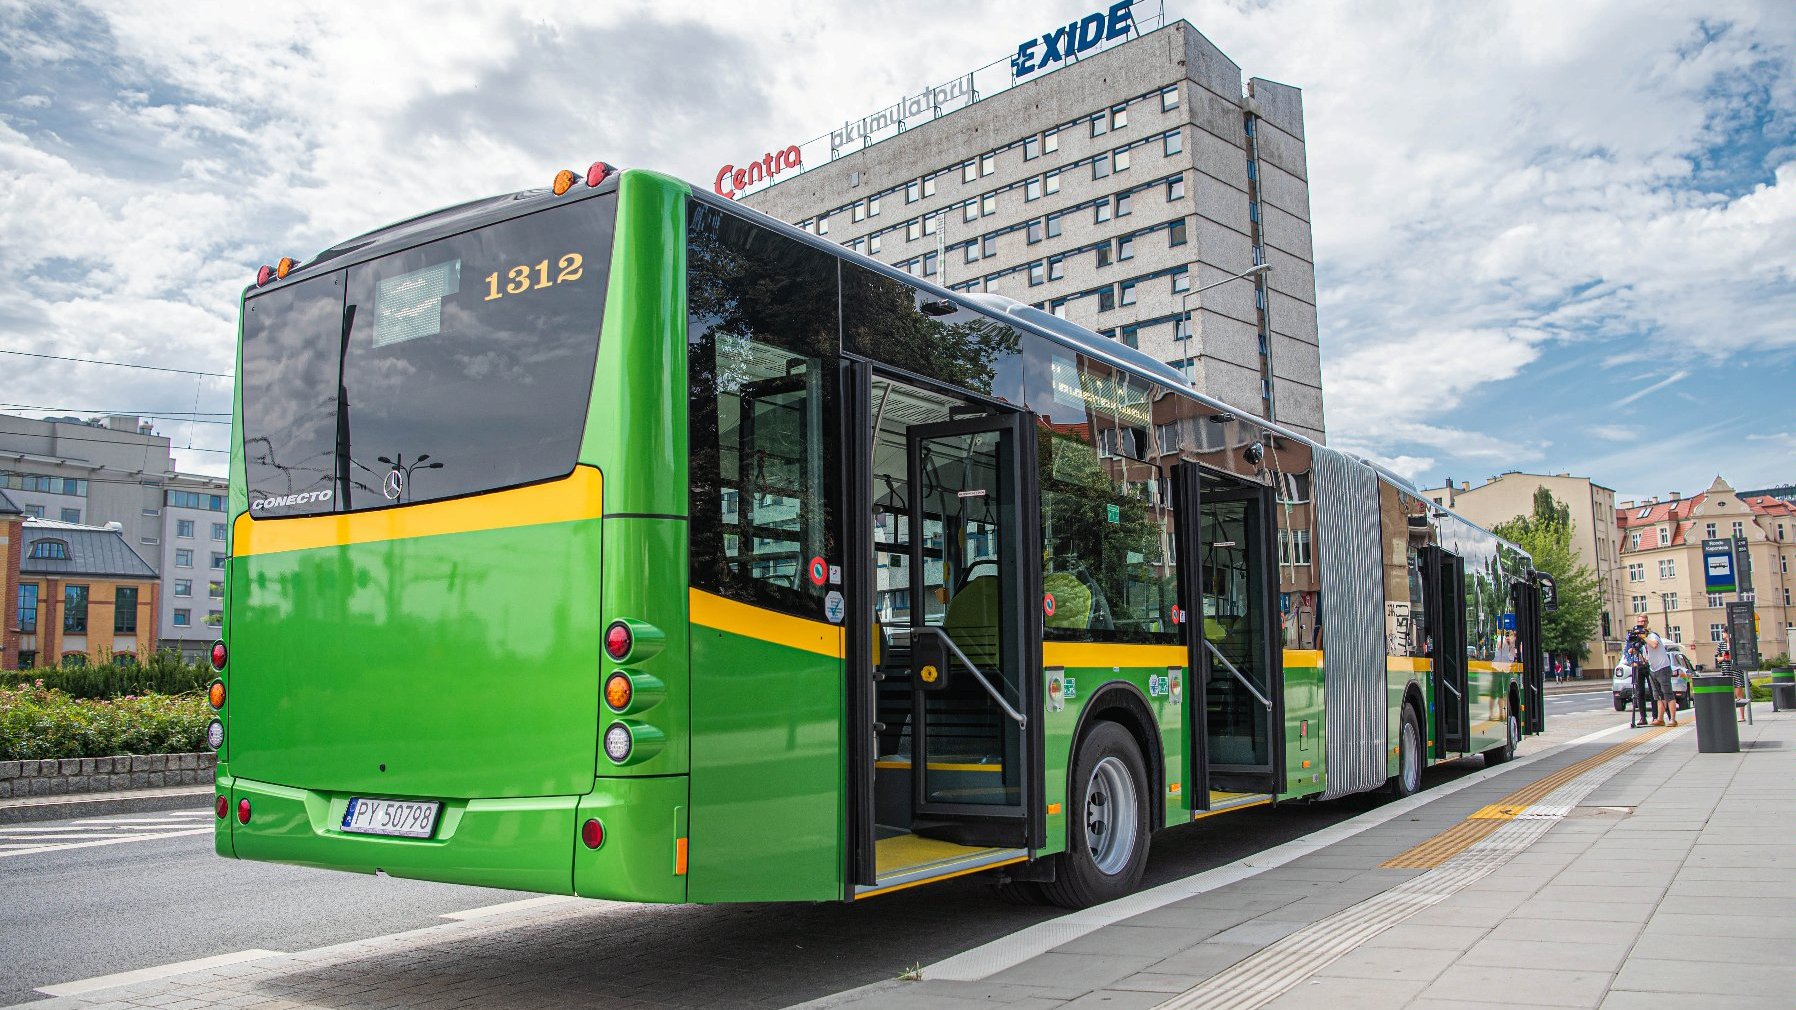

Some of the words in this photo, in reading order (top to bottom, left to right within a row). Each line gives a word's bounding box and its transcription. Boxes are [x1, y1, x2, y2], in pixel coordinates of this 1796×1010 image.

[1011, 0, 1134, 78] EXIDE
[831, 74, 973, 149] akumulatory
[715, 145, 802, 200] Centra
[484, 253, 583, 301] 1312
[252, 489, 333, 510] CONECTO
[354, 802, 381, 826] PY
[381, 803, 432, 829] 50798
